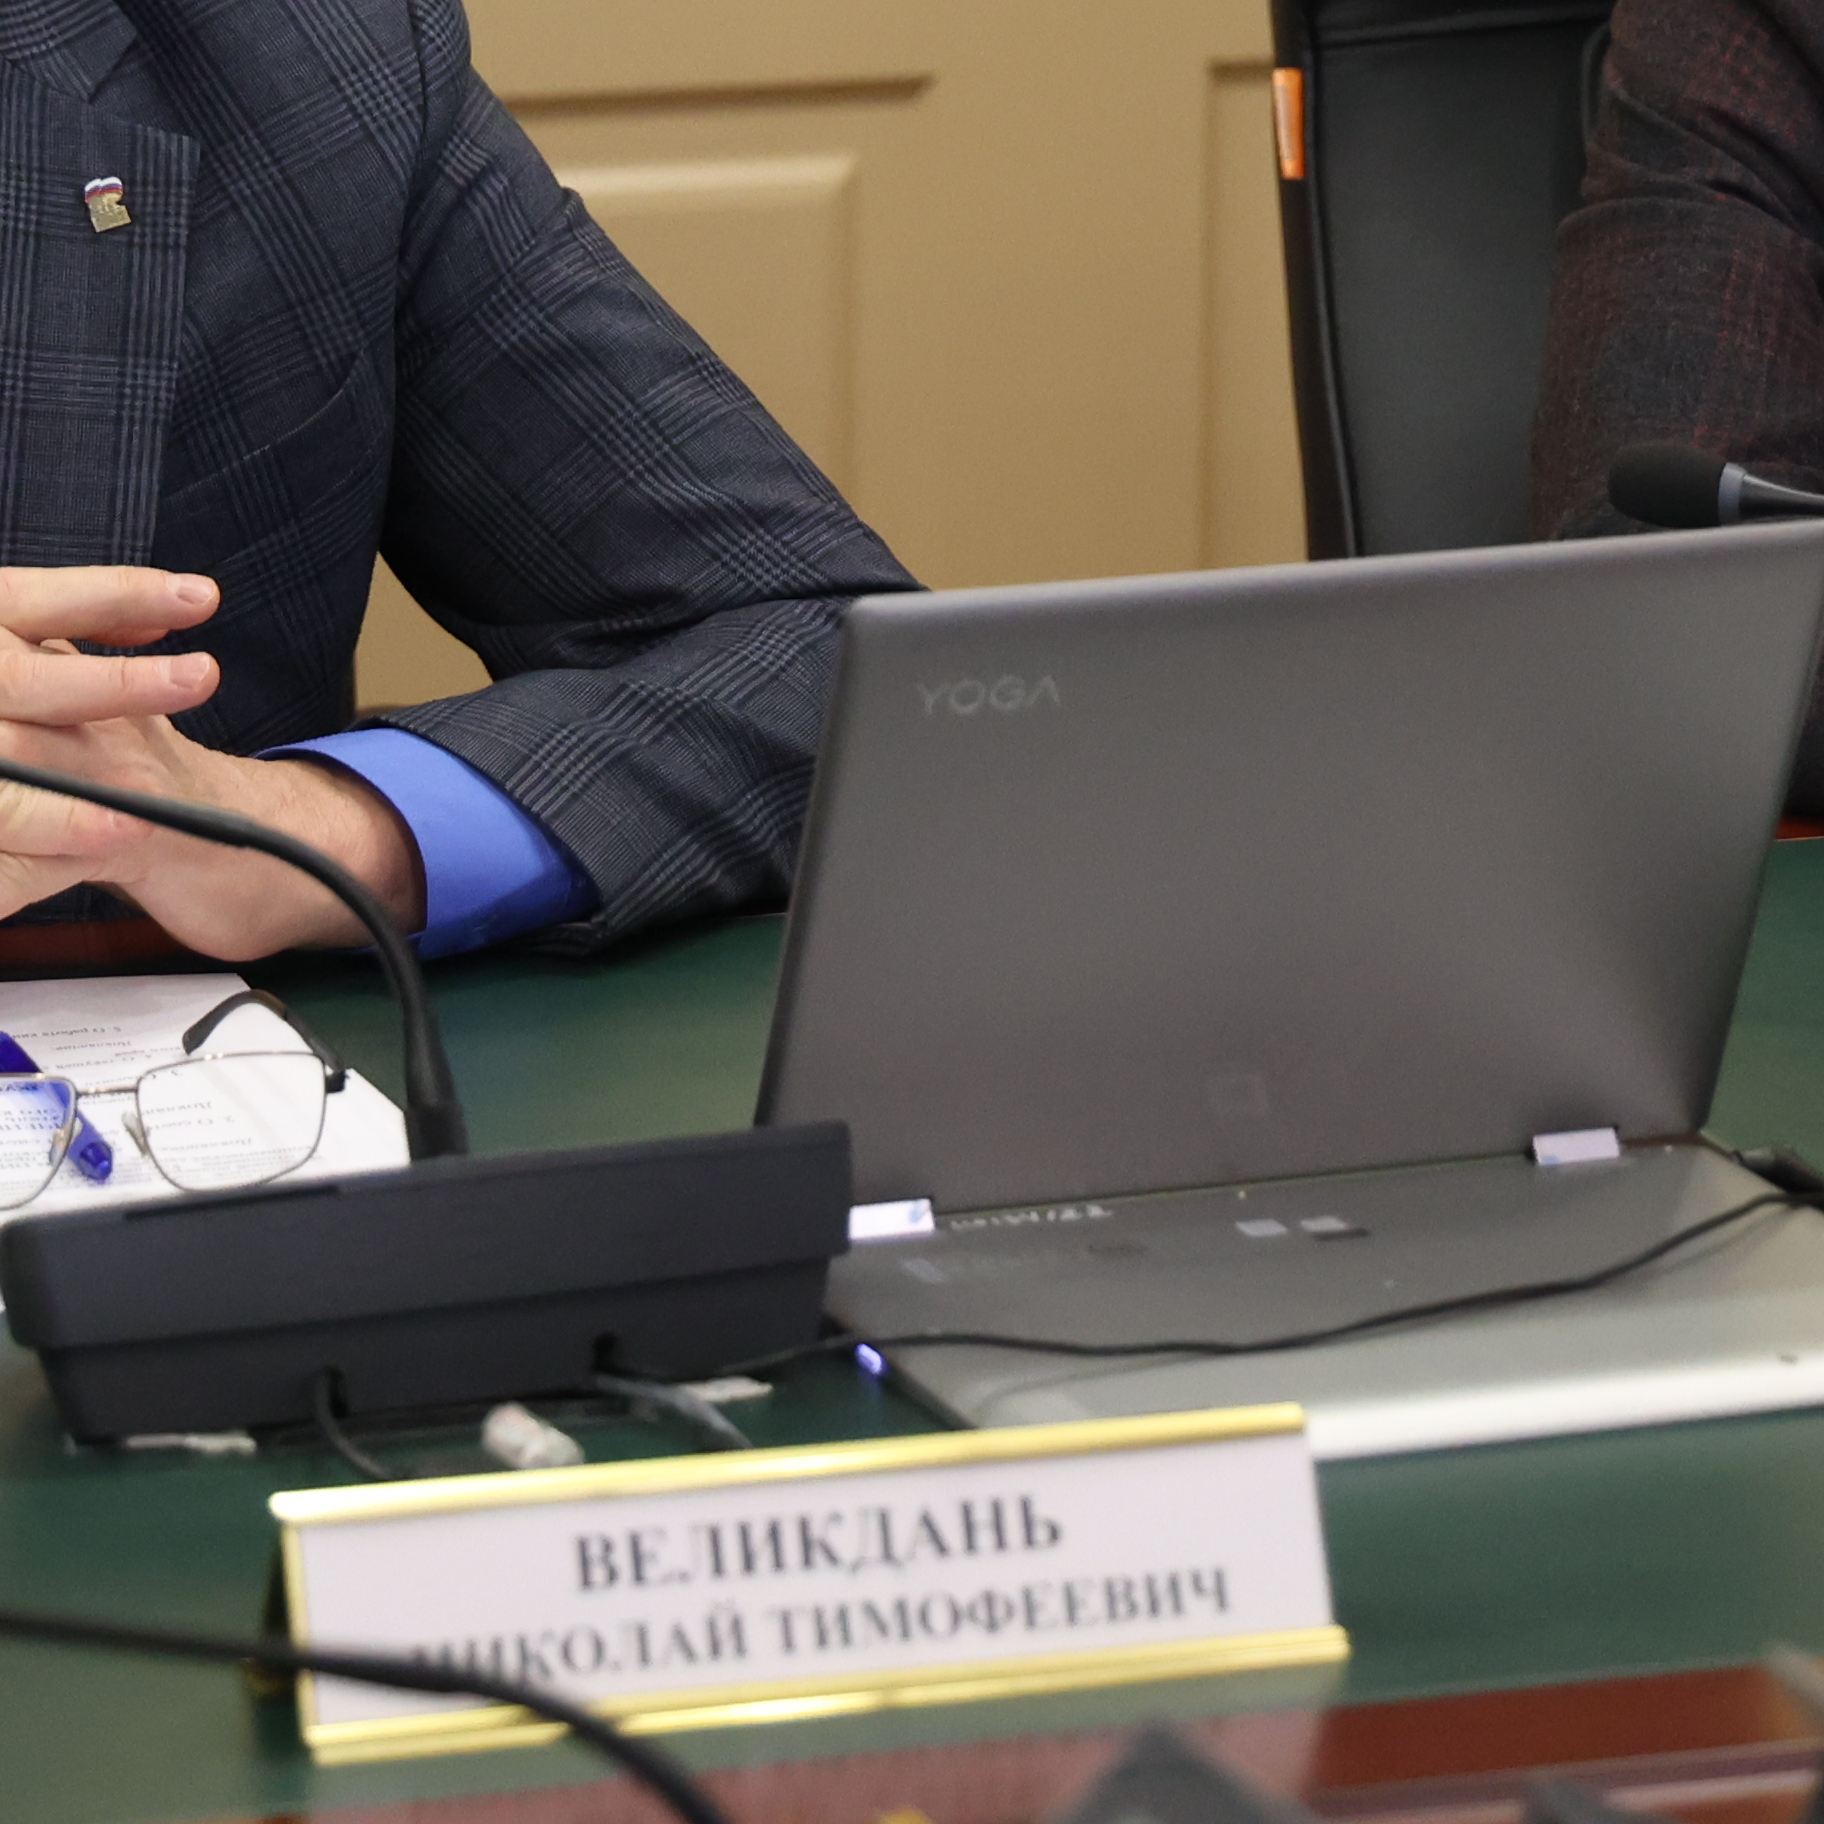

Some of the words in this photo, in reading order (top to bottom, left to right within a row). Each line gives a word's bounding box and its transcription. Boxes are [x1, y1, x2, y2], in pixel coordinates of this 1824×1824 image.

[917, 675, 1061, 717] YOGA
[573, 1494, 1064, 1591] ВЕЛИКДАНЬ
[773, 1566, 1232, 1656] ТИМОФЕЕВИЧ
